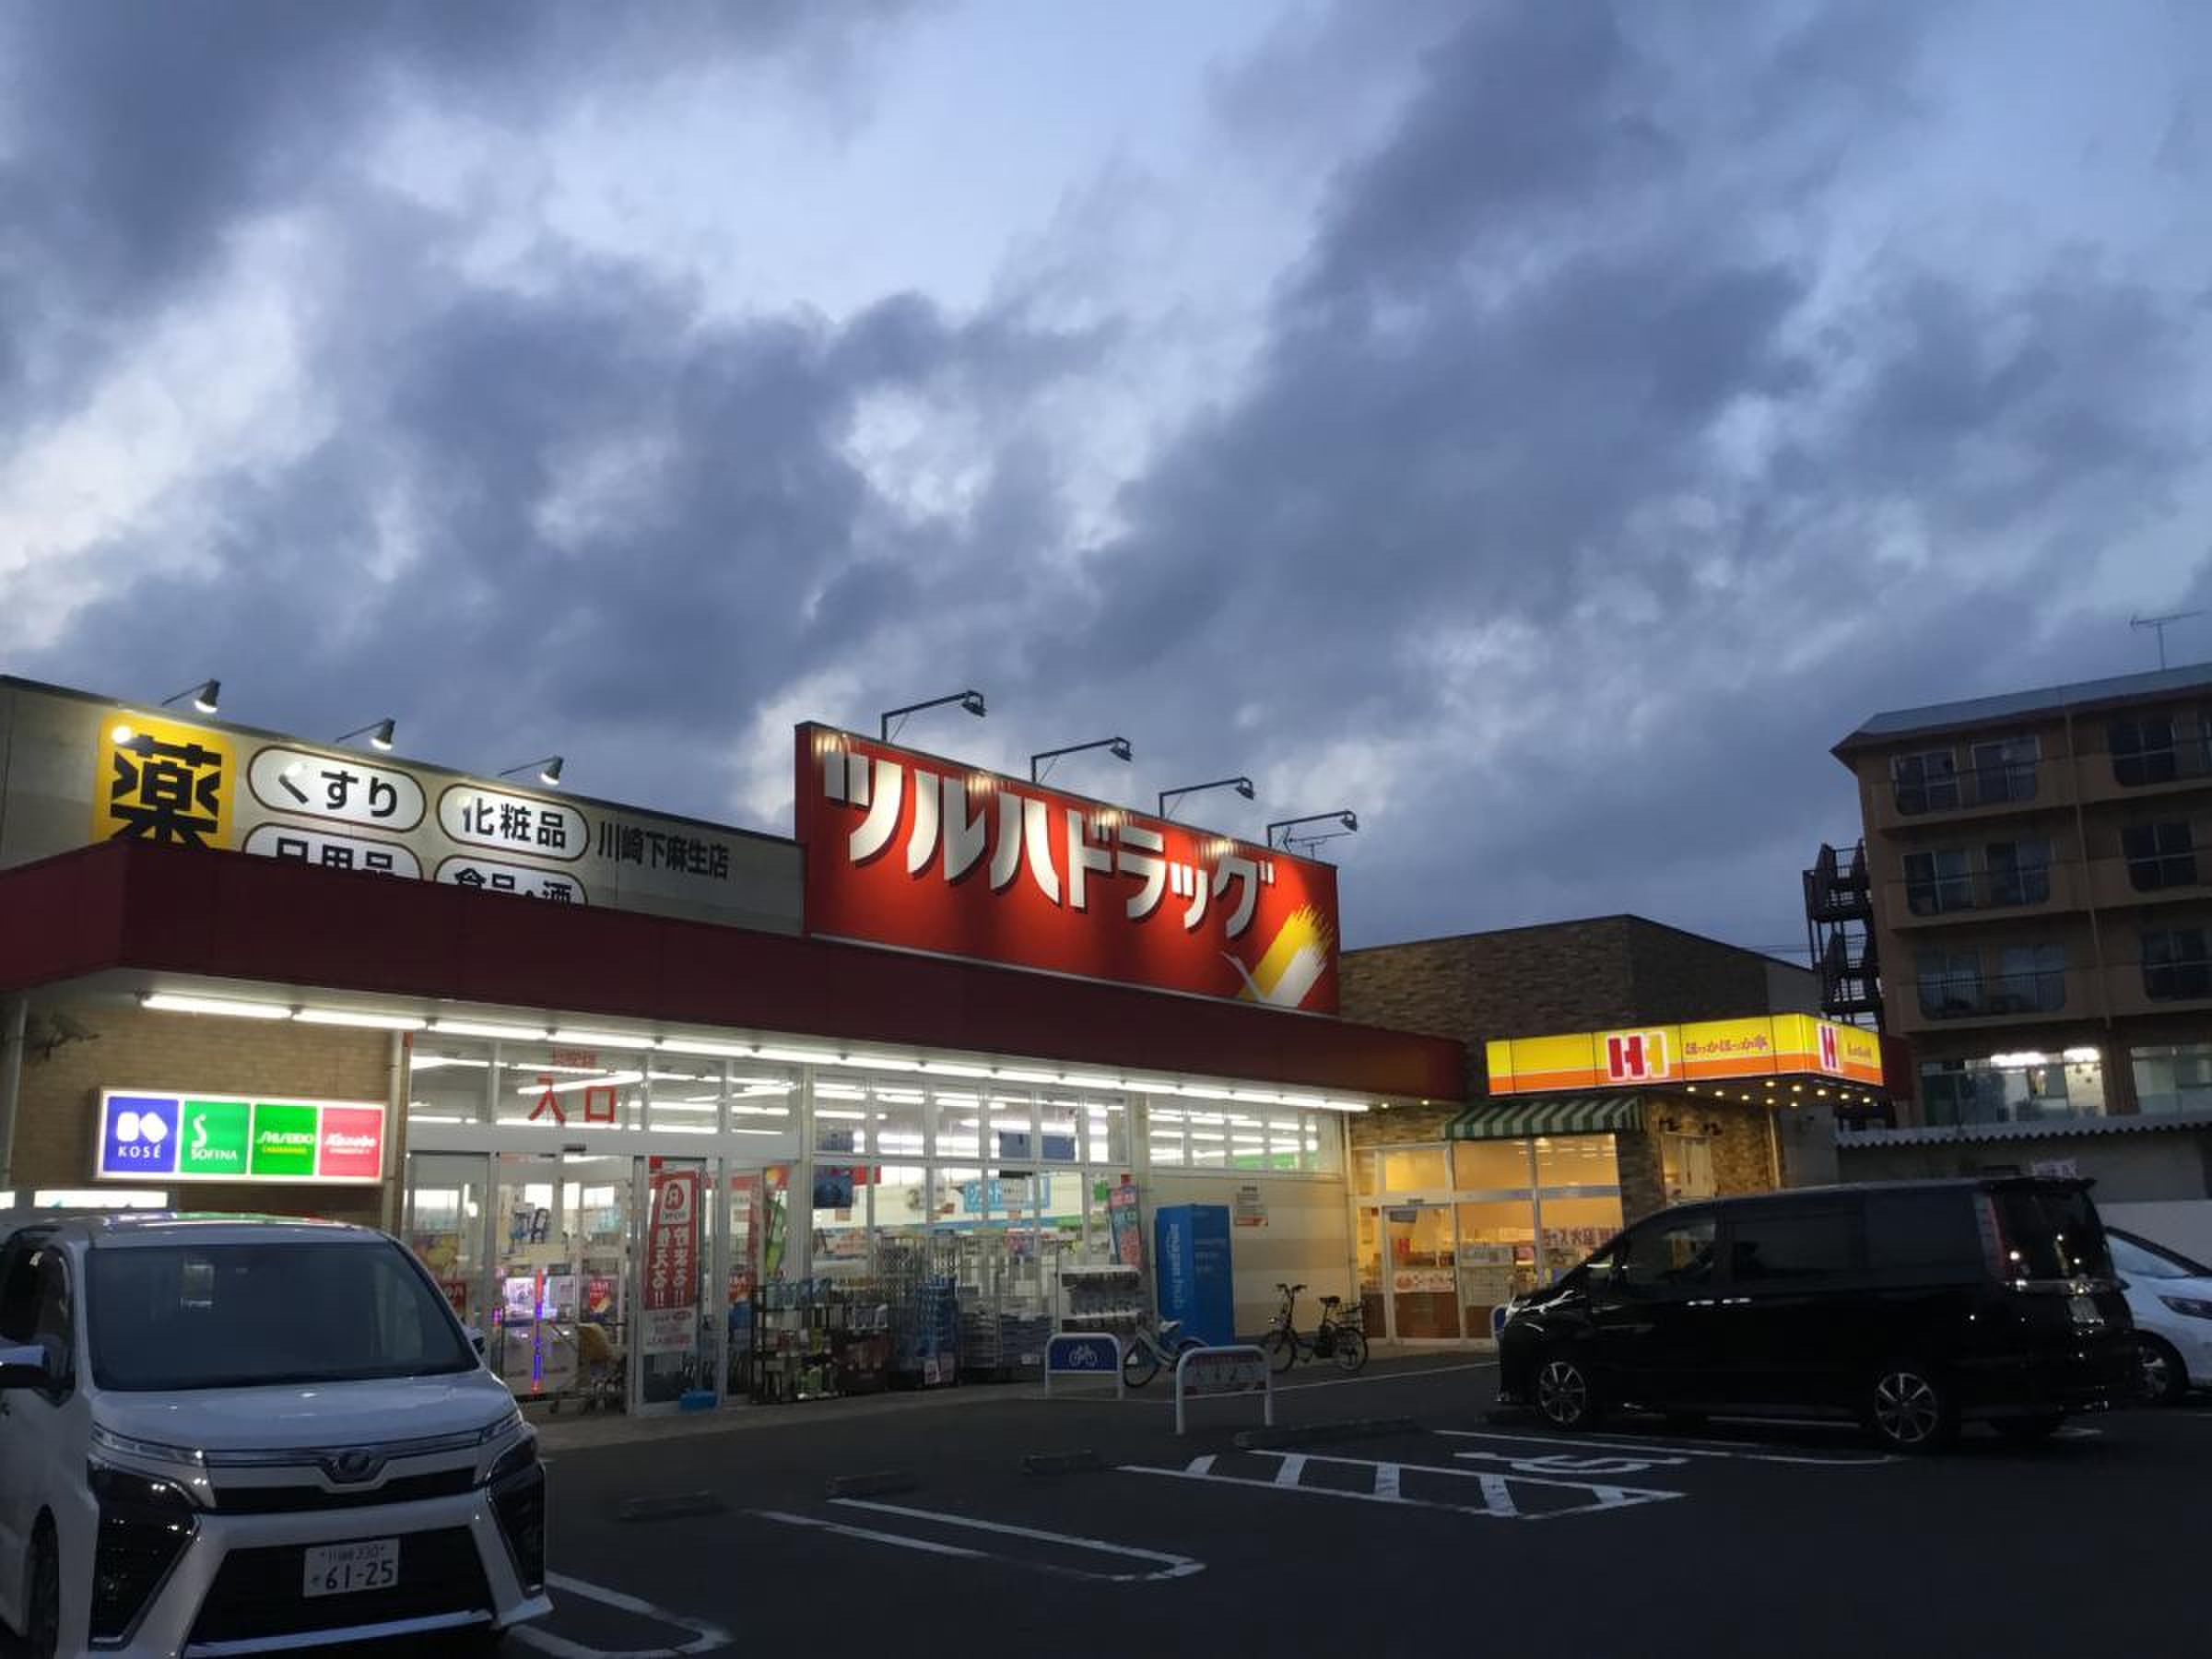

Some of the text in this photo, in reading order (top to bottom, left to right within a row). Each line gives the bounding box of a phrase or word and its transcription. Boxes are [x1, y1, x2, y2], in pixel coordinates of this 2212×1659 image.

[110, 735, 222, 850] 薬
[278, 763, 398, 818] くすり
[462, 797, 567, 850] 化粧品
[597, 821, 729, 880] 川崎下麻生店
[823, 750, 1275, 939] ツルハドラッグ
[528, 1072, 618, 1124] 入口
[326, 1559, 394, 1589] 61-25
